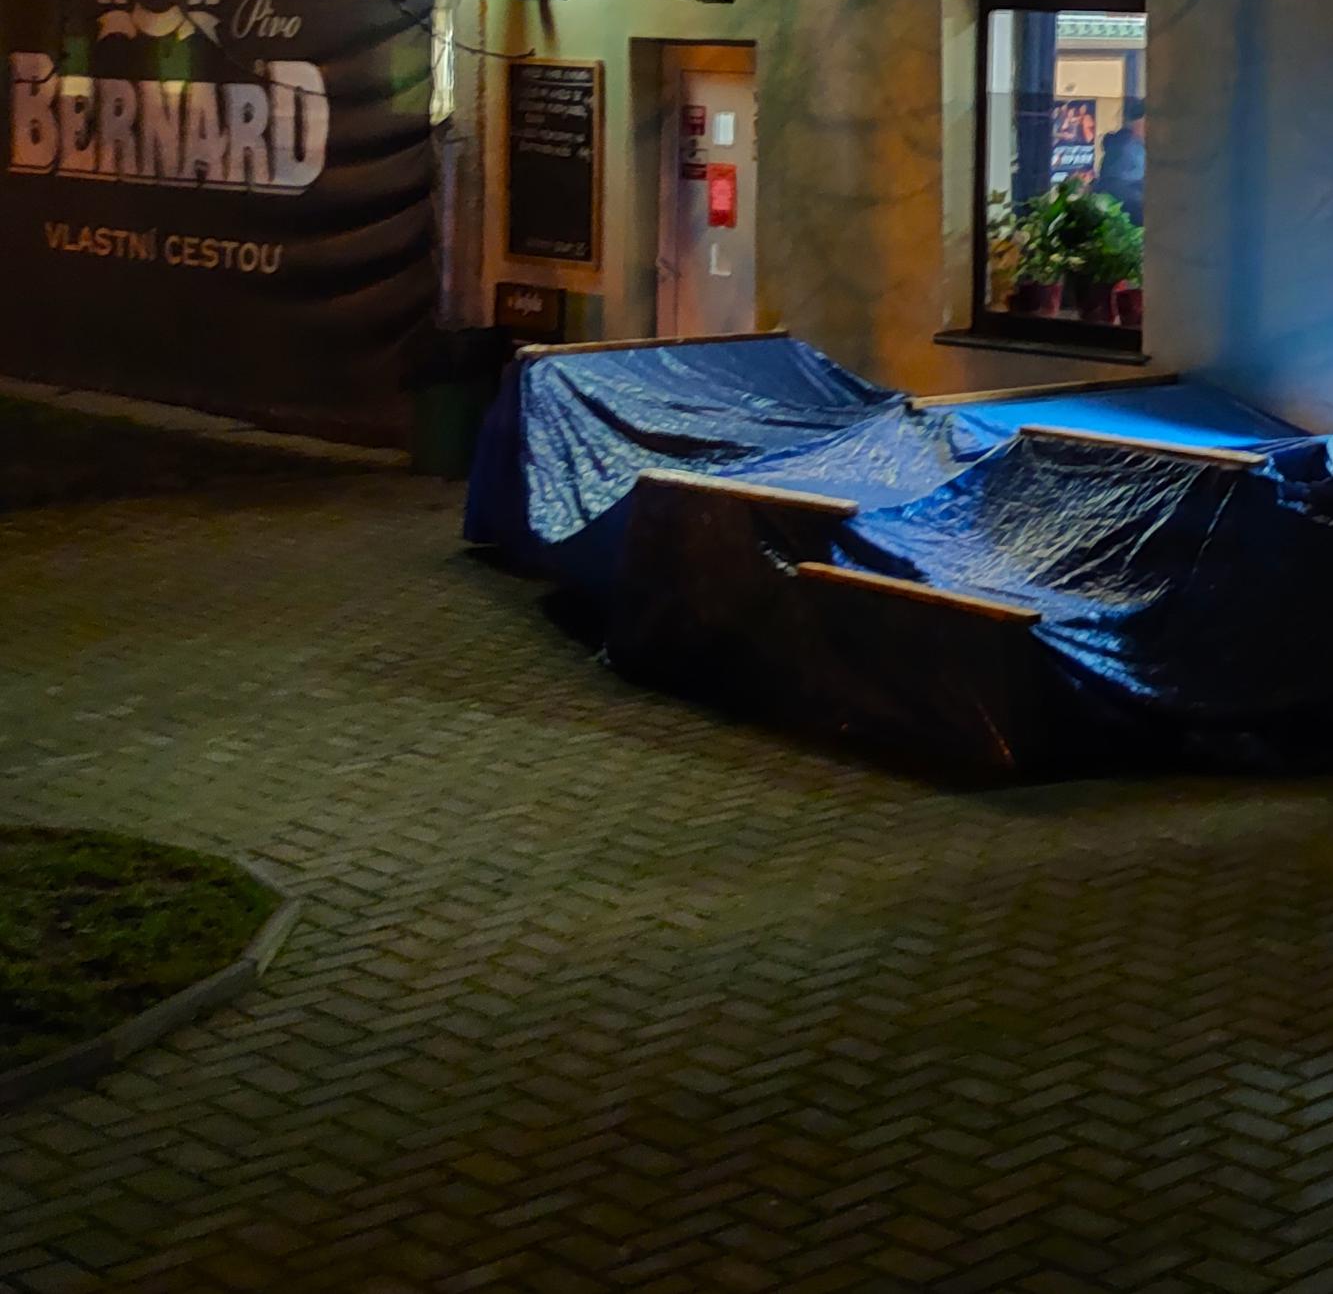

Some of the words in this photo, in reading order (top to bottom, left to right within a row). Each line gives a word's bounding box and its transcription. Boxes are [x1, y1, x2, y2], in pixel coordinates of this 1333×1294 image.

[8, 52, 330, 194] BERNARD
[44, 220, 157, 262] VLASTNÍ
[164, 234, 284, 275] CESTOU
